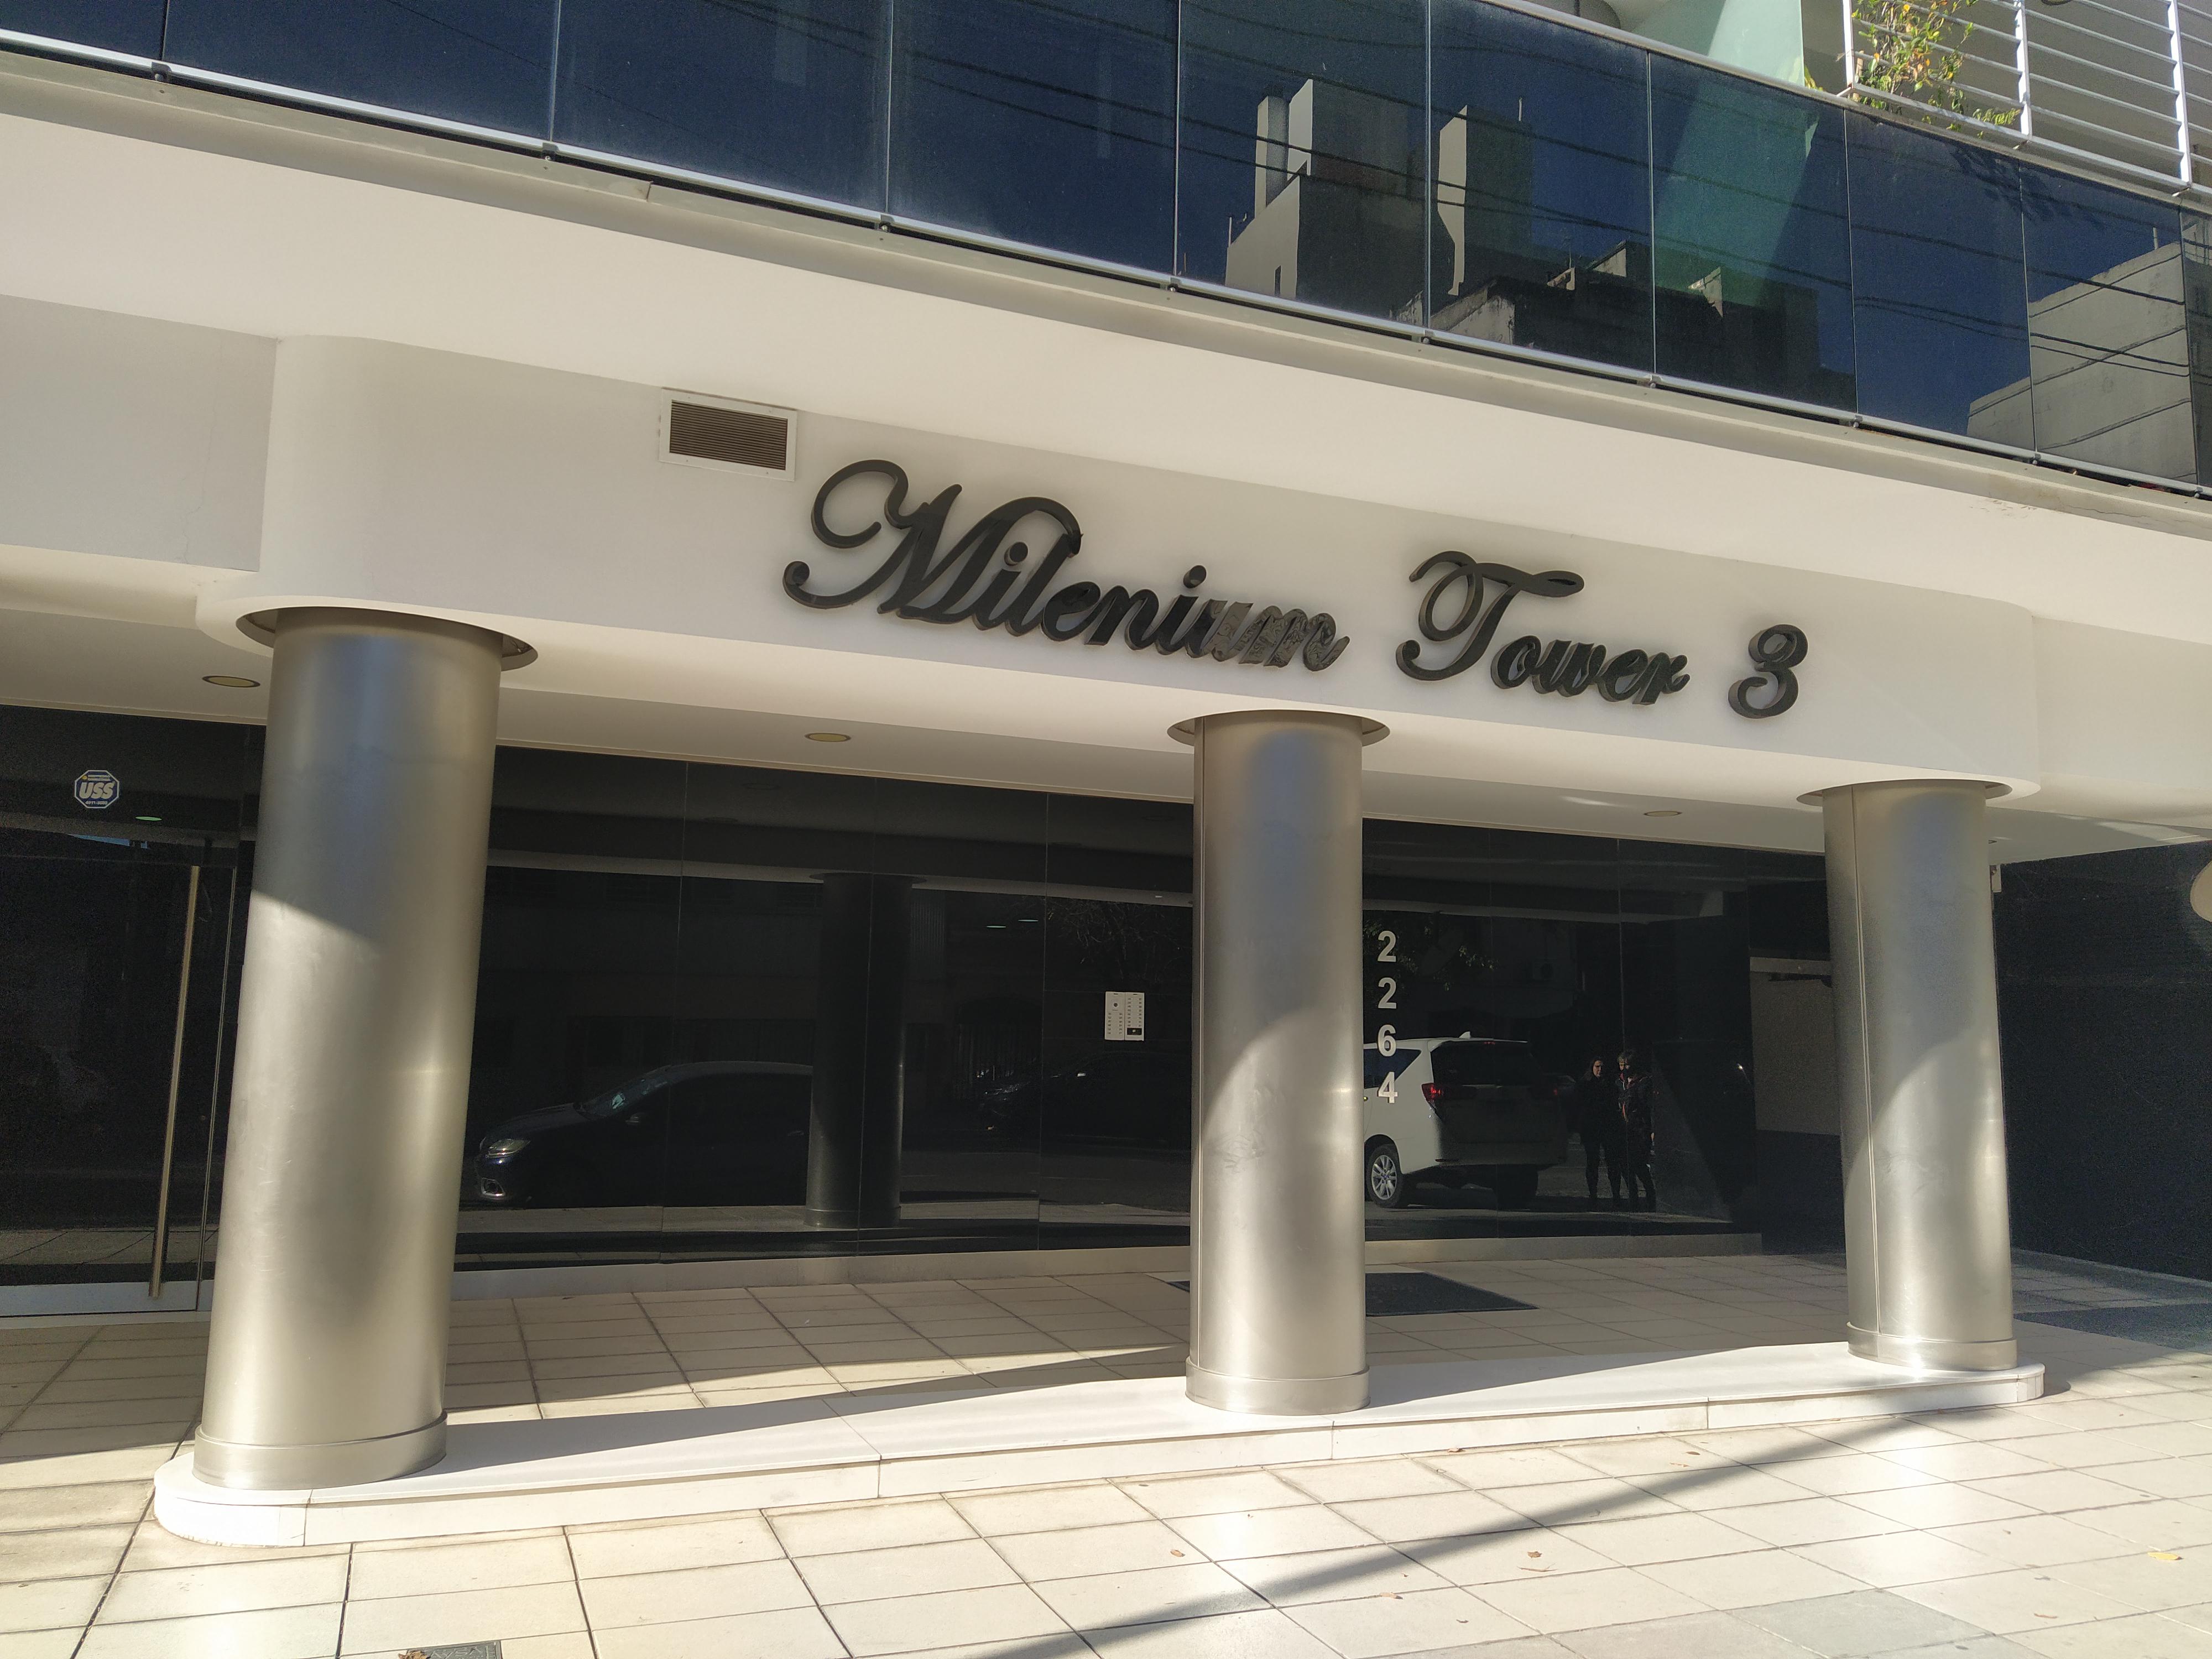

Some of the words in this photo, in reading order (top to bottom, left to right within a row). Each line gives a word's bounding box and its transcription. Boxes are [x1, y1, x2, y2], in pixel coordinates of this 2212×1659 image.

[783, 459, 1350, 672] Milenium
[1396, 551, 1690, 705] Tower
[1728, 624, 1808, 719] 3
[79, 782, 115, 799] USS
[1377, 930, 1398, 1104] 2264
